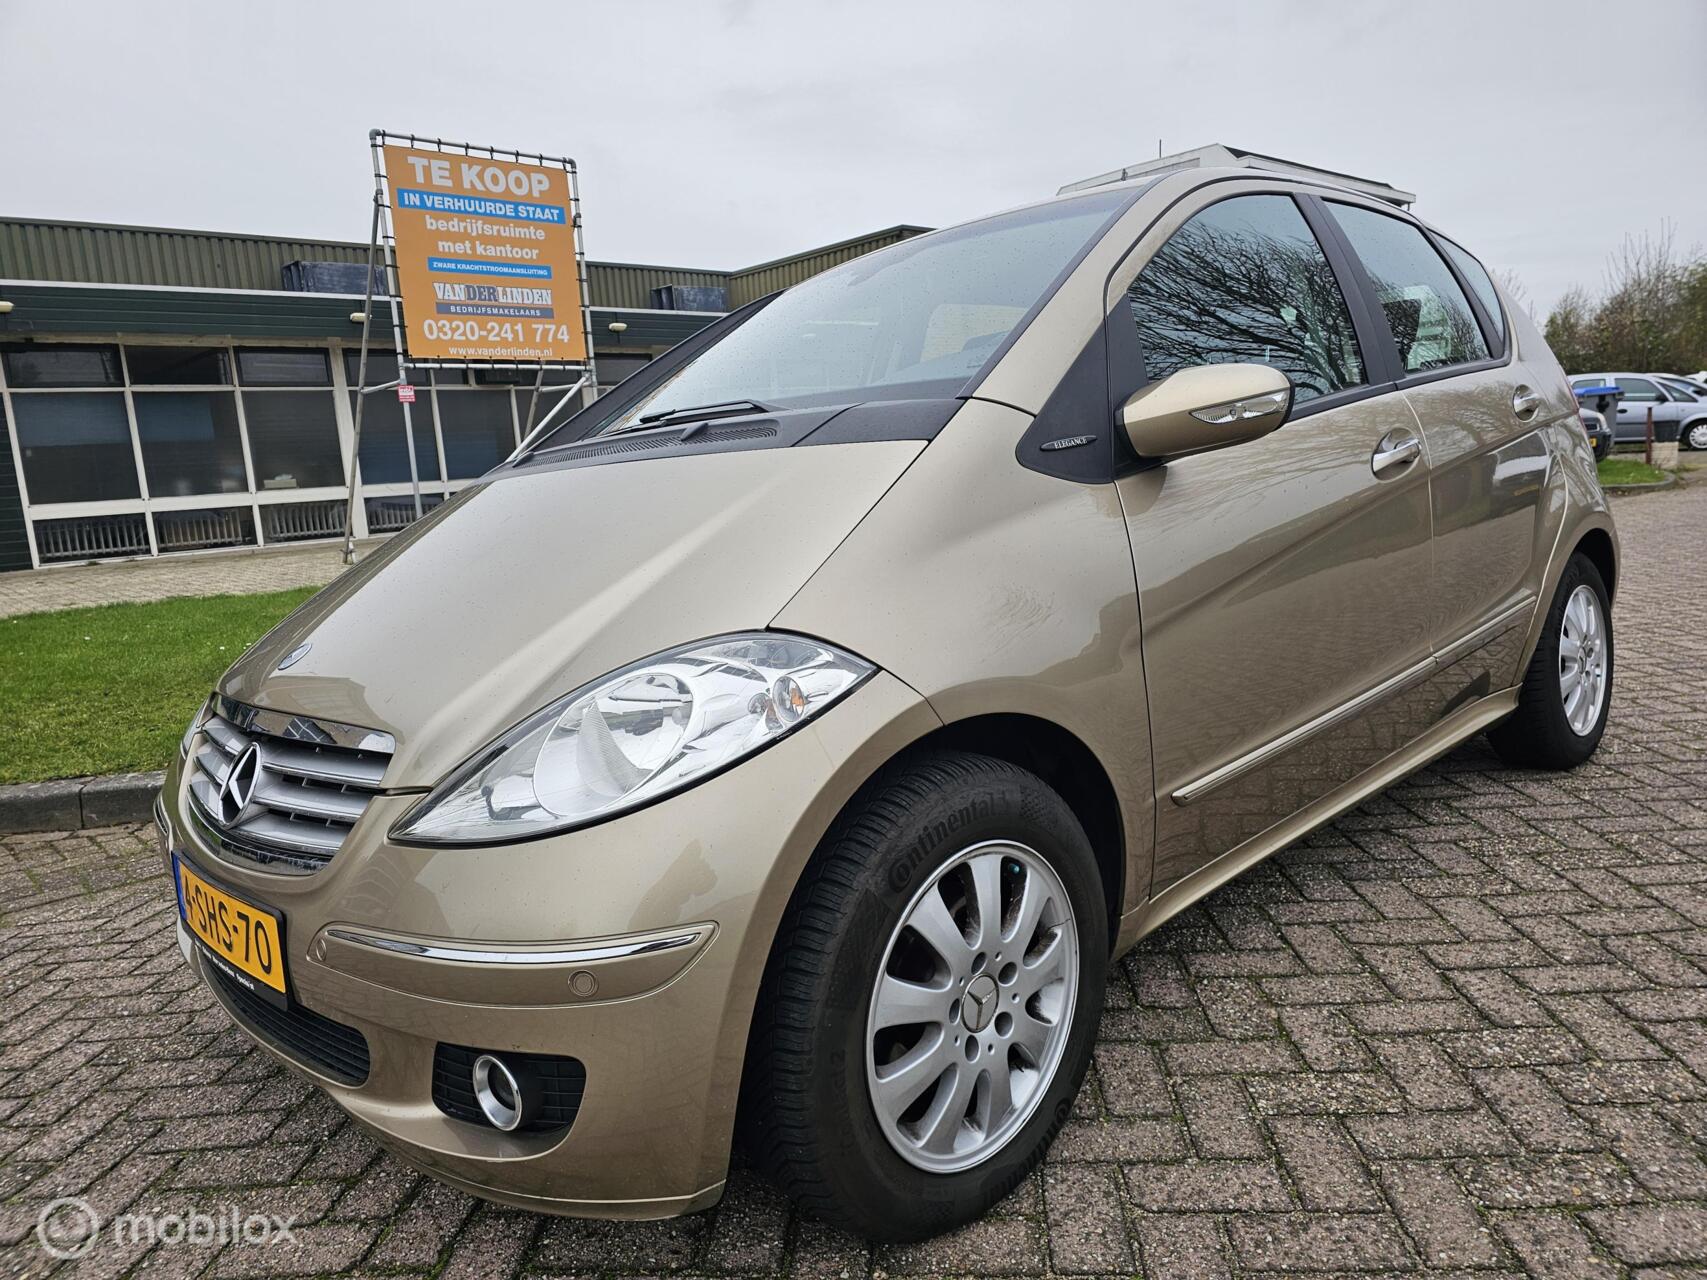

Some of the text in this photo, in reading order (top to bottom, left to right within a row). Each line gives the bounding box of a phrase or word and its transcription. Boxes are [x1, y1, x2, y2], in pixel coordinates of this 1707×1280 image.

[407, 156, 550, 198] TE KOOP
[404, 192, 559, 221] IN VERHUURDE STAAT
[425, 215, 545, 240] bedrijfsruimte
[438, 240, 539, 260] met kantoor
[432, 261, 456, 270] ZWARE
[450, 305, 541, 317] BEDRIJFSMAKELAARS
[423, 319, 570, 343] 0320-241 774
[448, 346, 553, 357] www.vanderlinden.nl
[1054, 437, 1088, 449] ELEGANCE
[888, 791, 997, 894] Continental
[184, 875, 272, 975] 4-SHS-70
